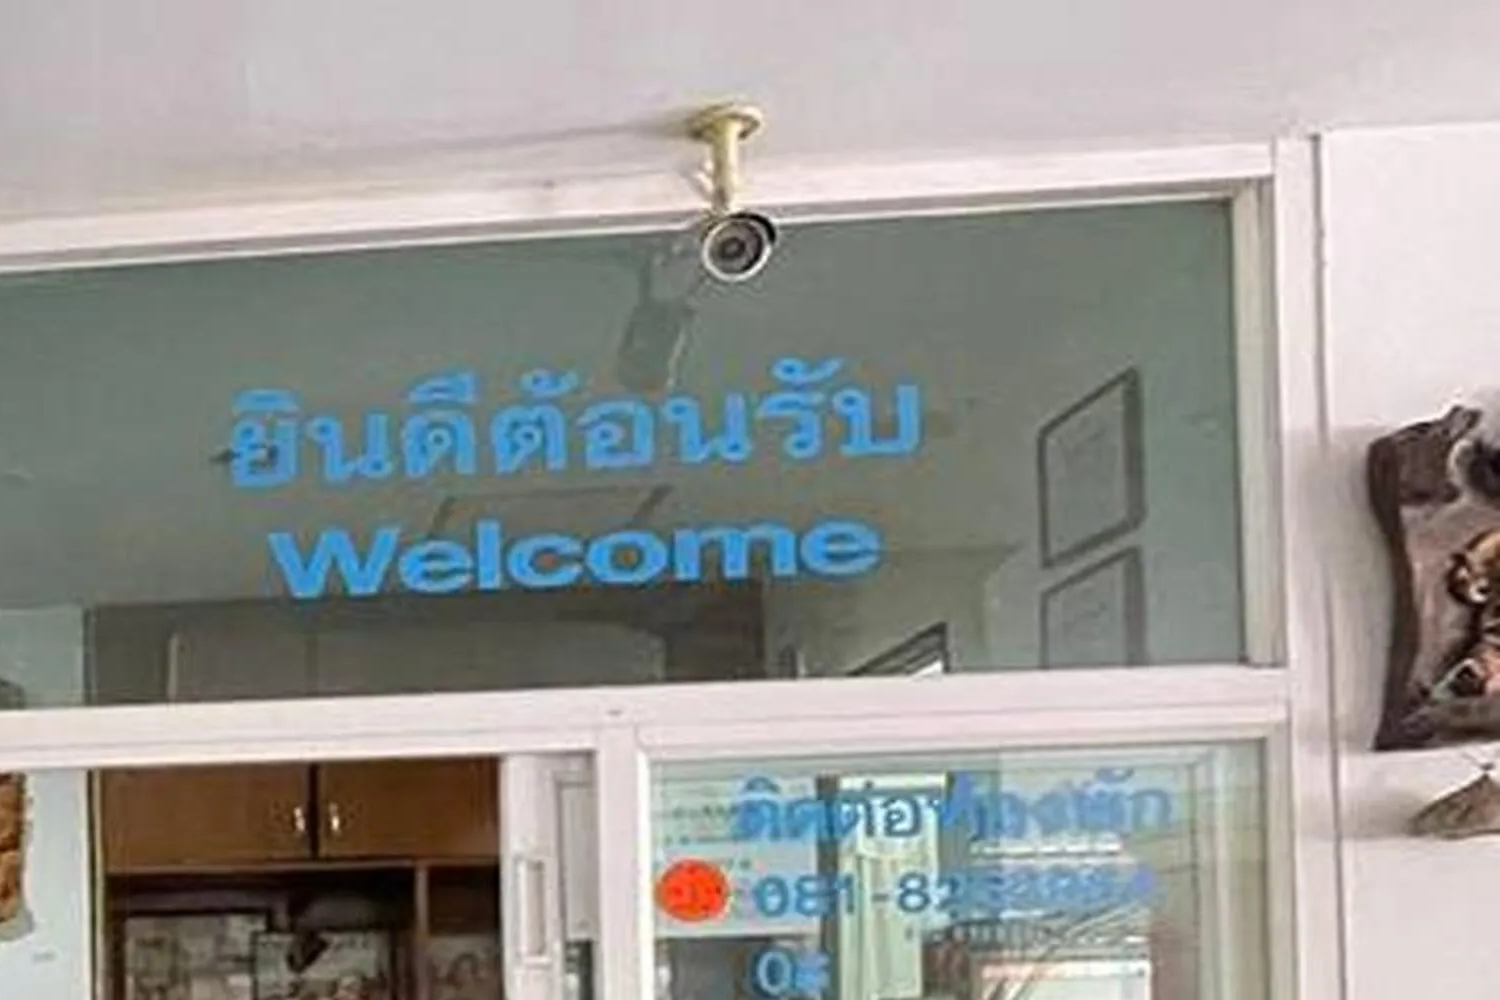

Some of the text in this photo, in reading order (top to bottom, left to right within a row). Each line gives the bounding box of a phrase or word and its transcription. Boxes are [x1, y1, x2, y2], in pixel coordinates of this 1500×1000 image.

[232, 357, 924, 487] ยินดีต้อนรับ
[268, 519, 882, 600] Welcome
